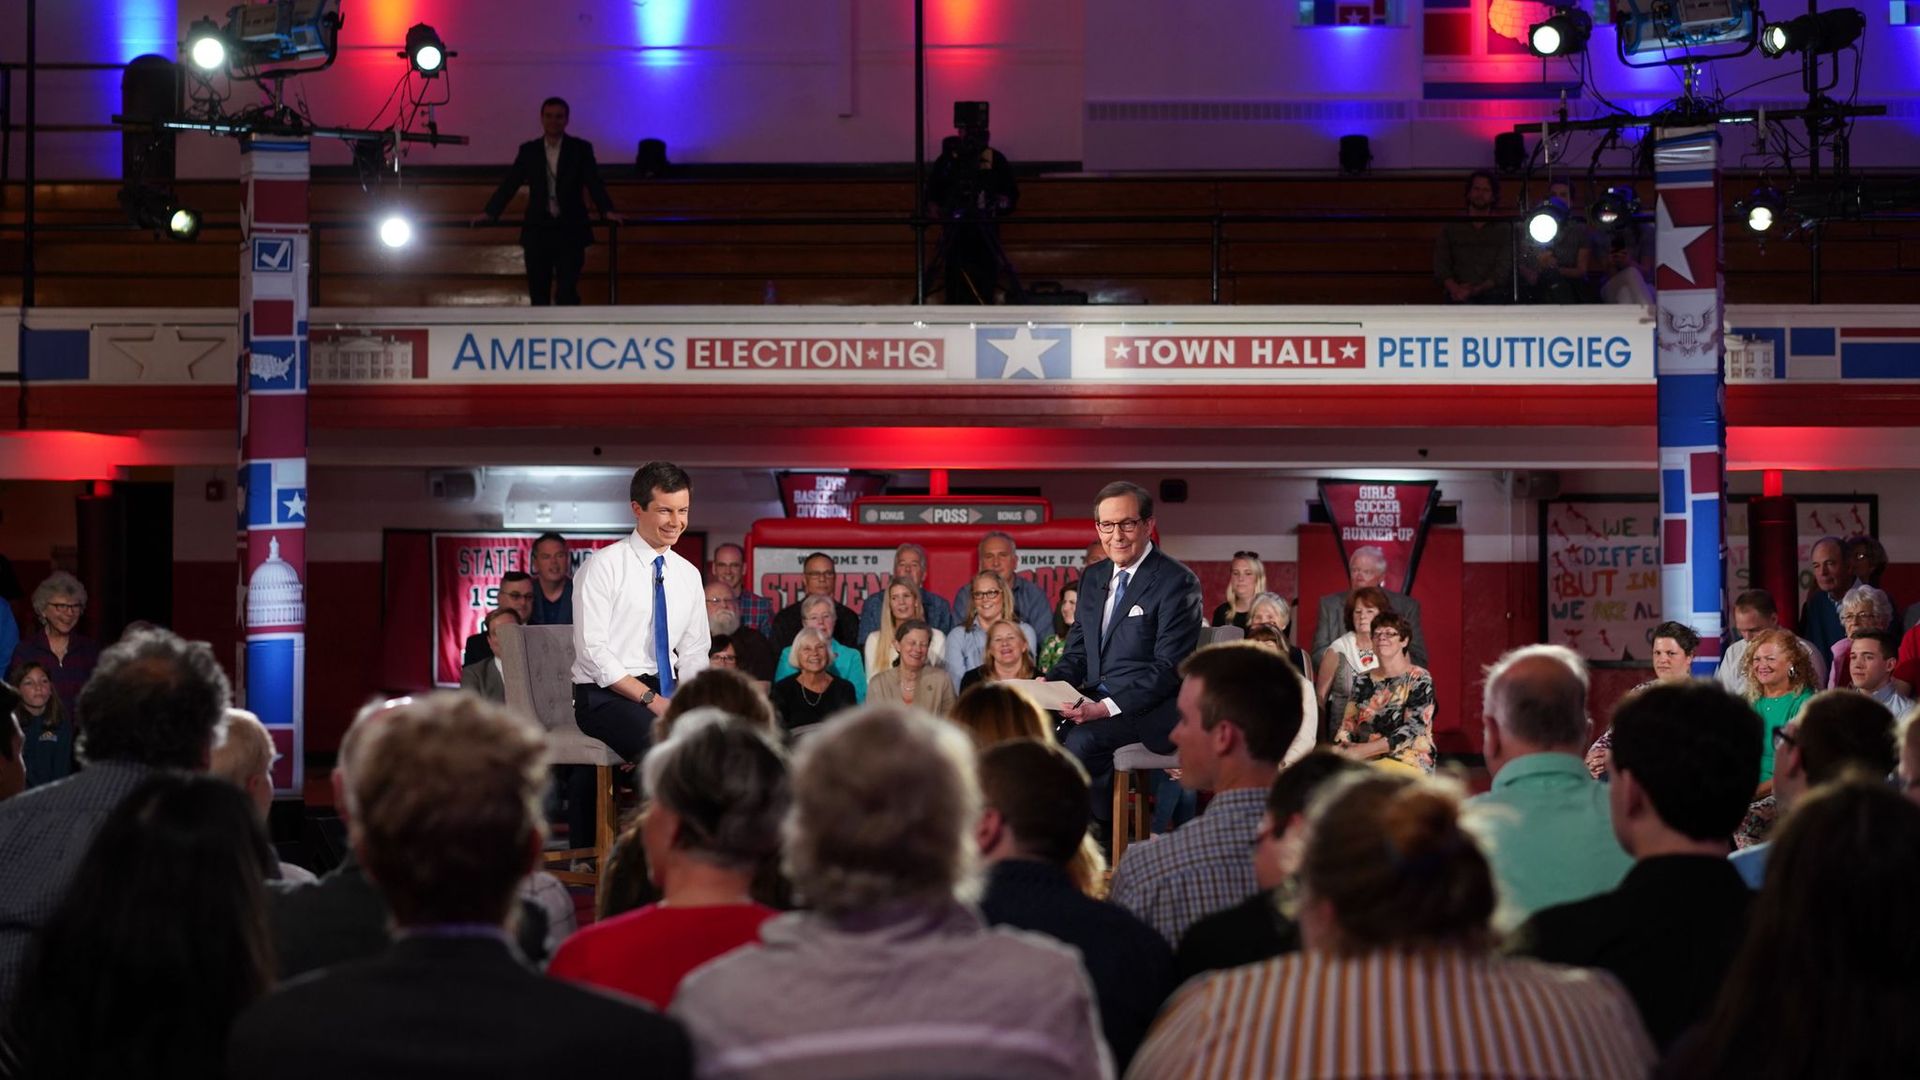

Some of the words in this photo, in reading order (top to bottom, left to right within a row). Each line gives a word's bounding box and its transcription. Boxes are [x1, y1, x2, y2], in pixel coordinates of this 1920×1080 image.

[452, 333, 675, 370] AMERICA'S
[694, 340, 863, 367] ELECTION
[1134, 339, 1235, 365] TOWN
[1251, 339, 1336, 365] HALL
[1378, 337, 1449, 368] PETE
[1462, 336, 1632, 368] BUTTIGIEG
[815, 476, 847, 490] BOYS
[1359, 486, 1396, 500] GIRLS
[1355, 500, 1400, 513] SOCCER
[880, 511, 905, 521] BONUS
[934, 508, 968, 523] POSS
[997, 511, 1022, 521] BONUS
[1355, 514, 1394, 526] CLASS
[1343, 527, 1415, 541] RUNNER-UP
[1603, 517, 1637, 537] WE
[459, 547, 518, 576] STATE
[863, 555, 878, 564] TO
[1021, 556, 1055, 565] HOME
[1060, 556, 1075, 565] OF
[1562, 569, 1618, 597] BUT
[1551, 601, 1585, 620] WE
